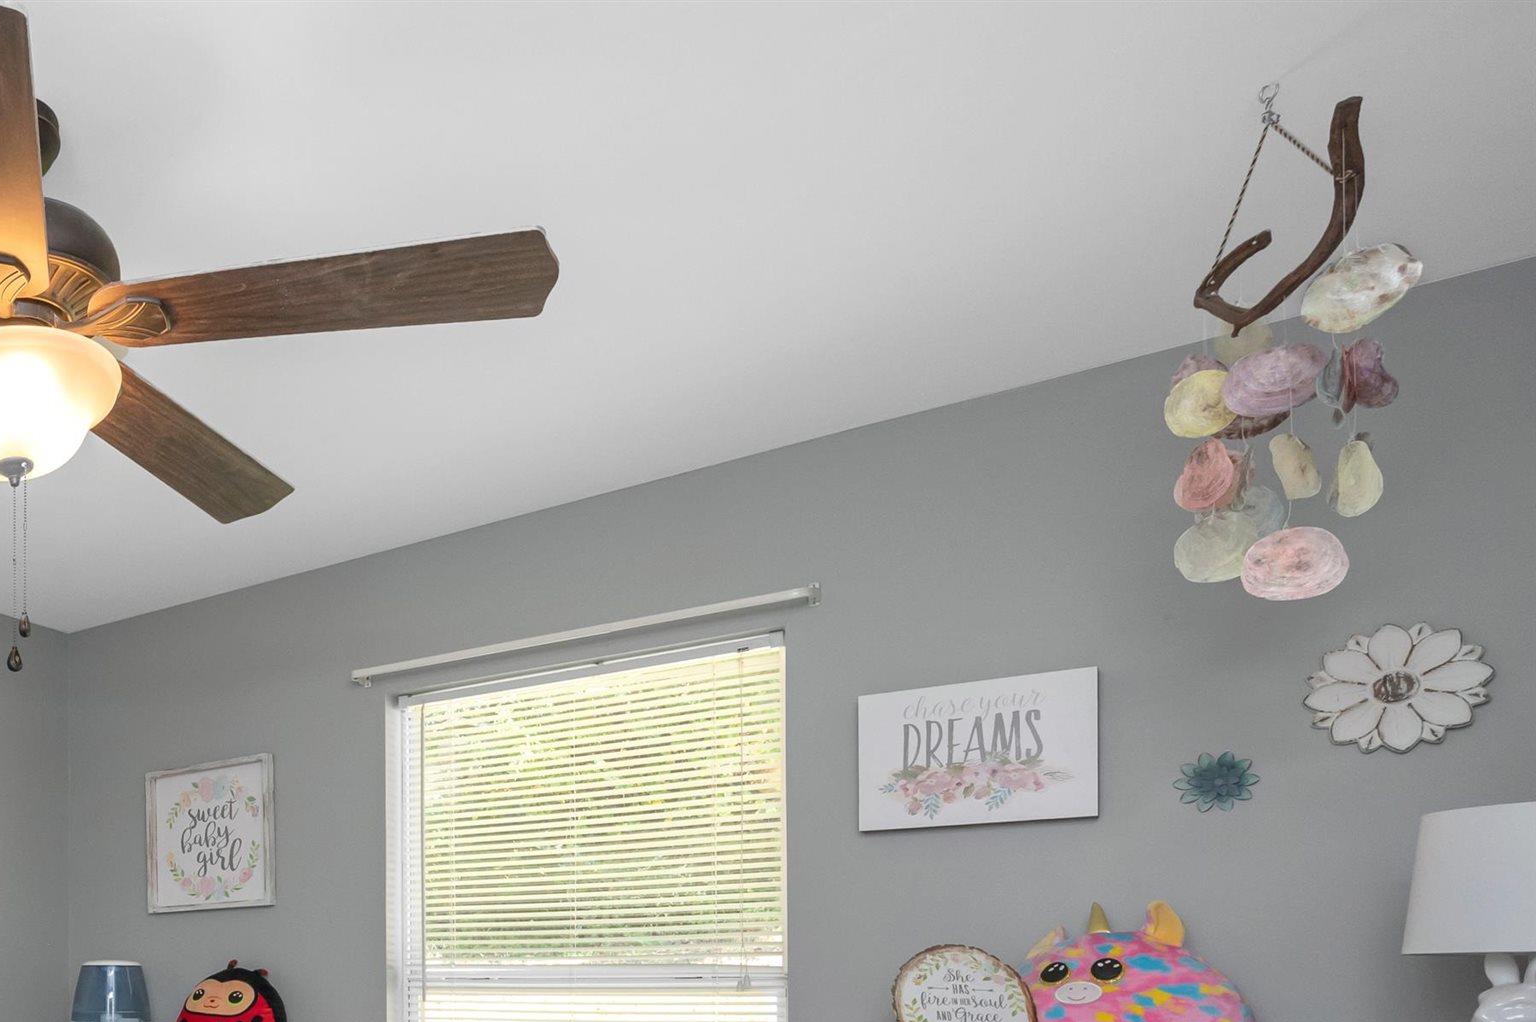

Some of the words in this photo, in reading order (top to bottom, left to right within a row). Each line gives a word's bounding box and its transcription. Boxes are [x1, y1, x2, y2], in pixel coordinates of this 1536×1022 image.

[904, 695, 969, 719] chase
[903, 709, 1043, 769] DREAMS
[188, 799, 239, 830] sweet
[181, 821, 235, 854] baby
[197, 838, 243, 877] girl
[943, 968, 975, 983] She
[921, 992, 951, 1009] fire
[952, 984, 970, 995] HAS
[936, 1010, 952, 1021] AND
